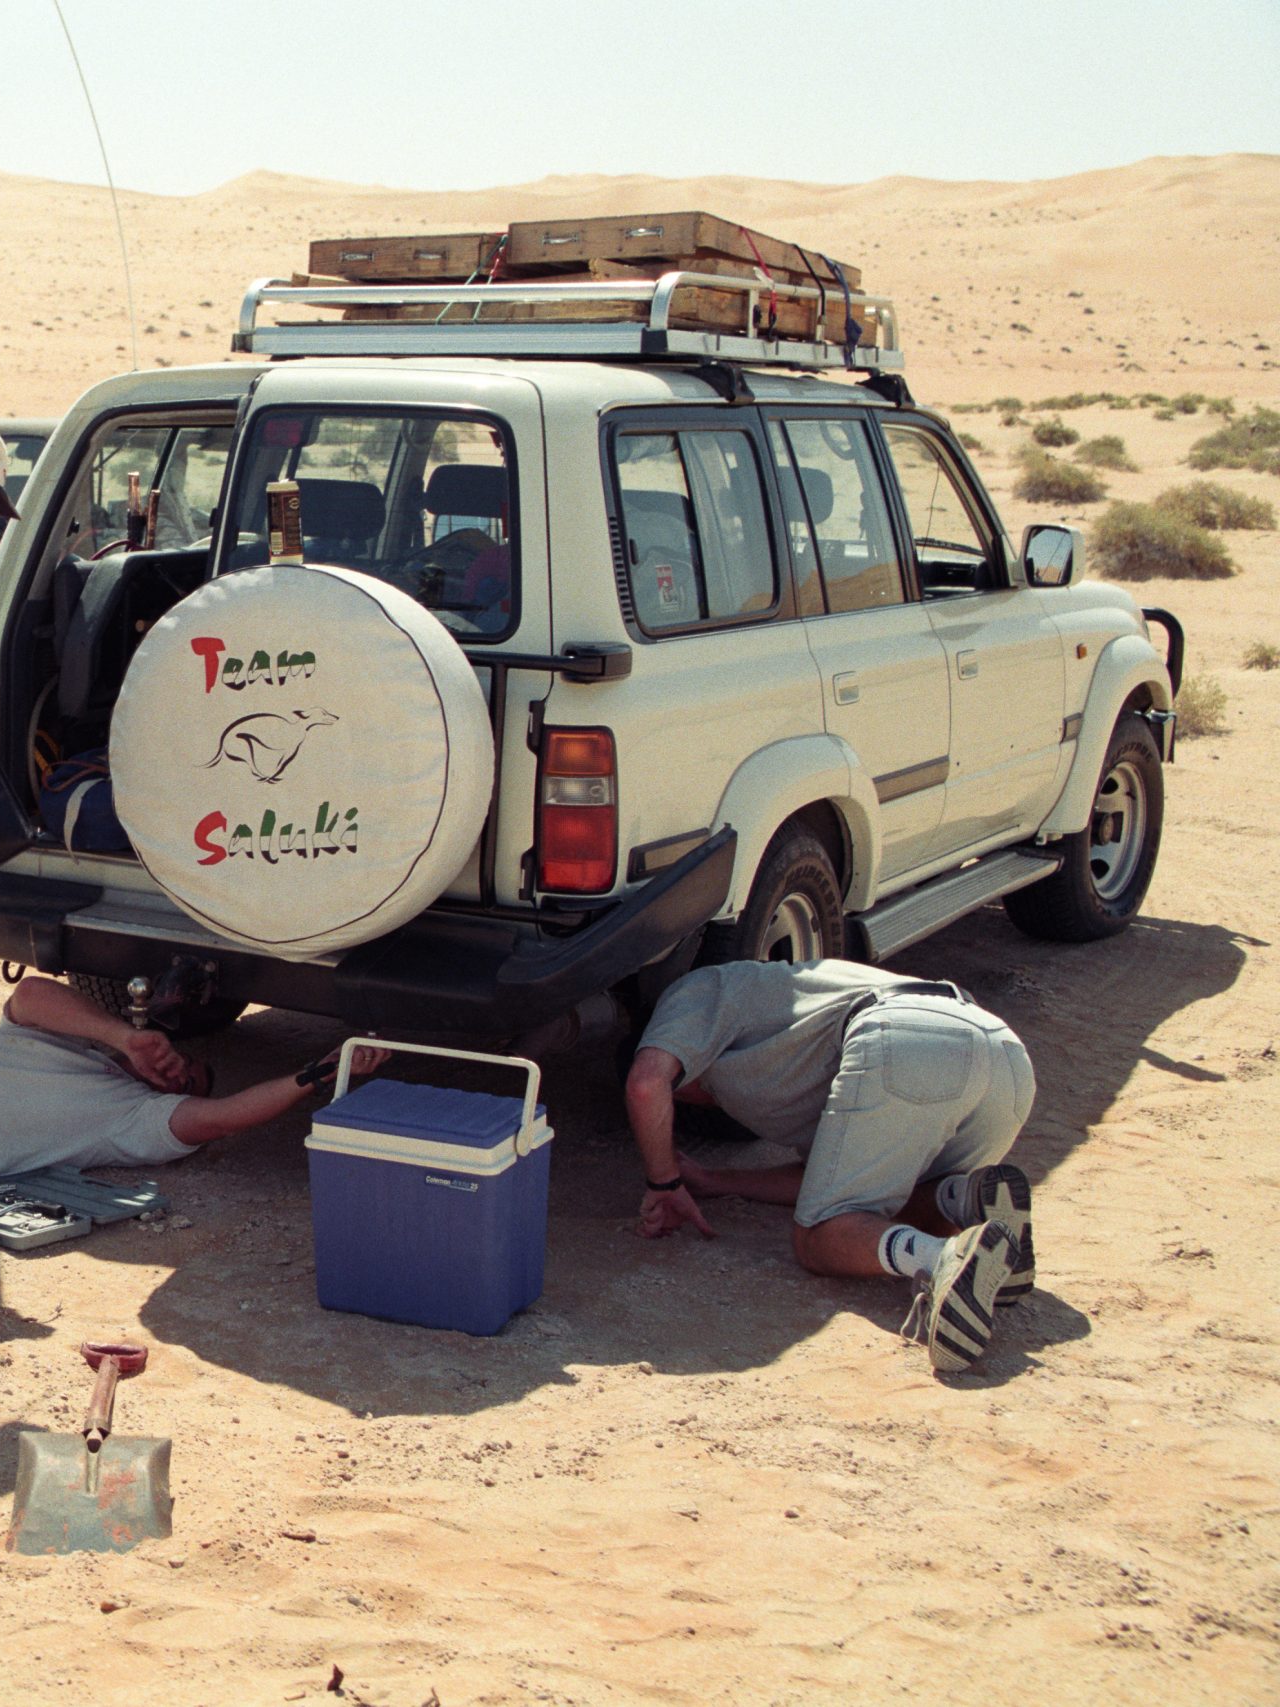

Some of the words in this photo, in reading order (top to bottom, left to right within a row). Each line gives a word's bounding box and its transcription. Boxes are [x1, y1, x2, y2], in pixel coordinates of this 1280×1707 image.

[190, 637, 316, 694] Team
[193, 801, 359, 866] Saluki
[786, 864, 842, 958] BRIDGESTON
